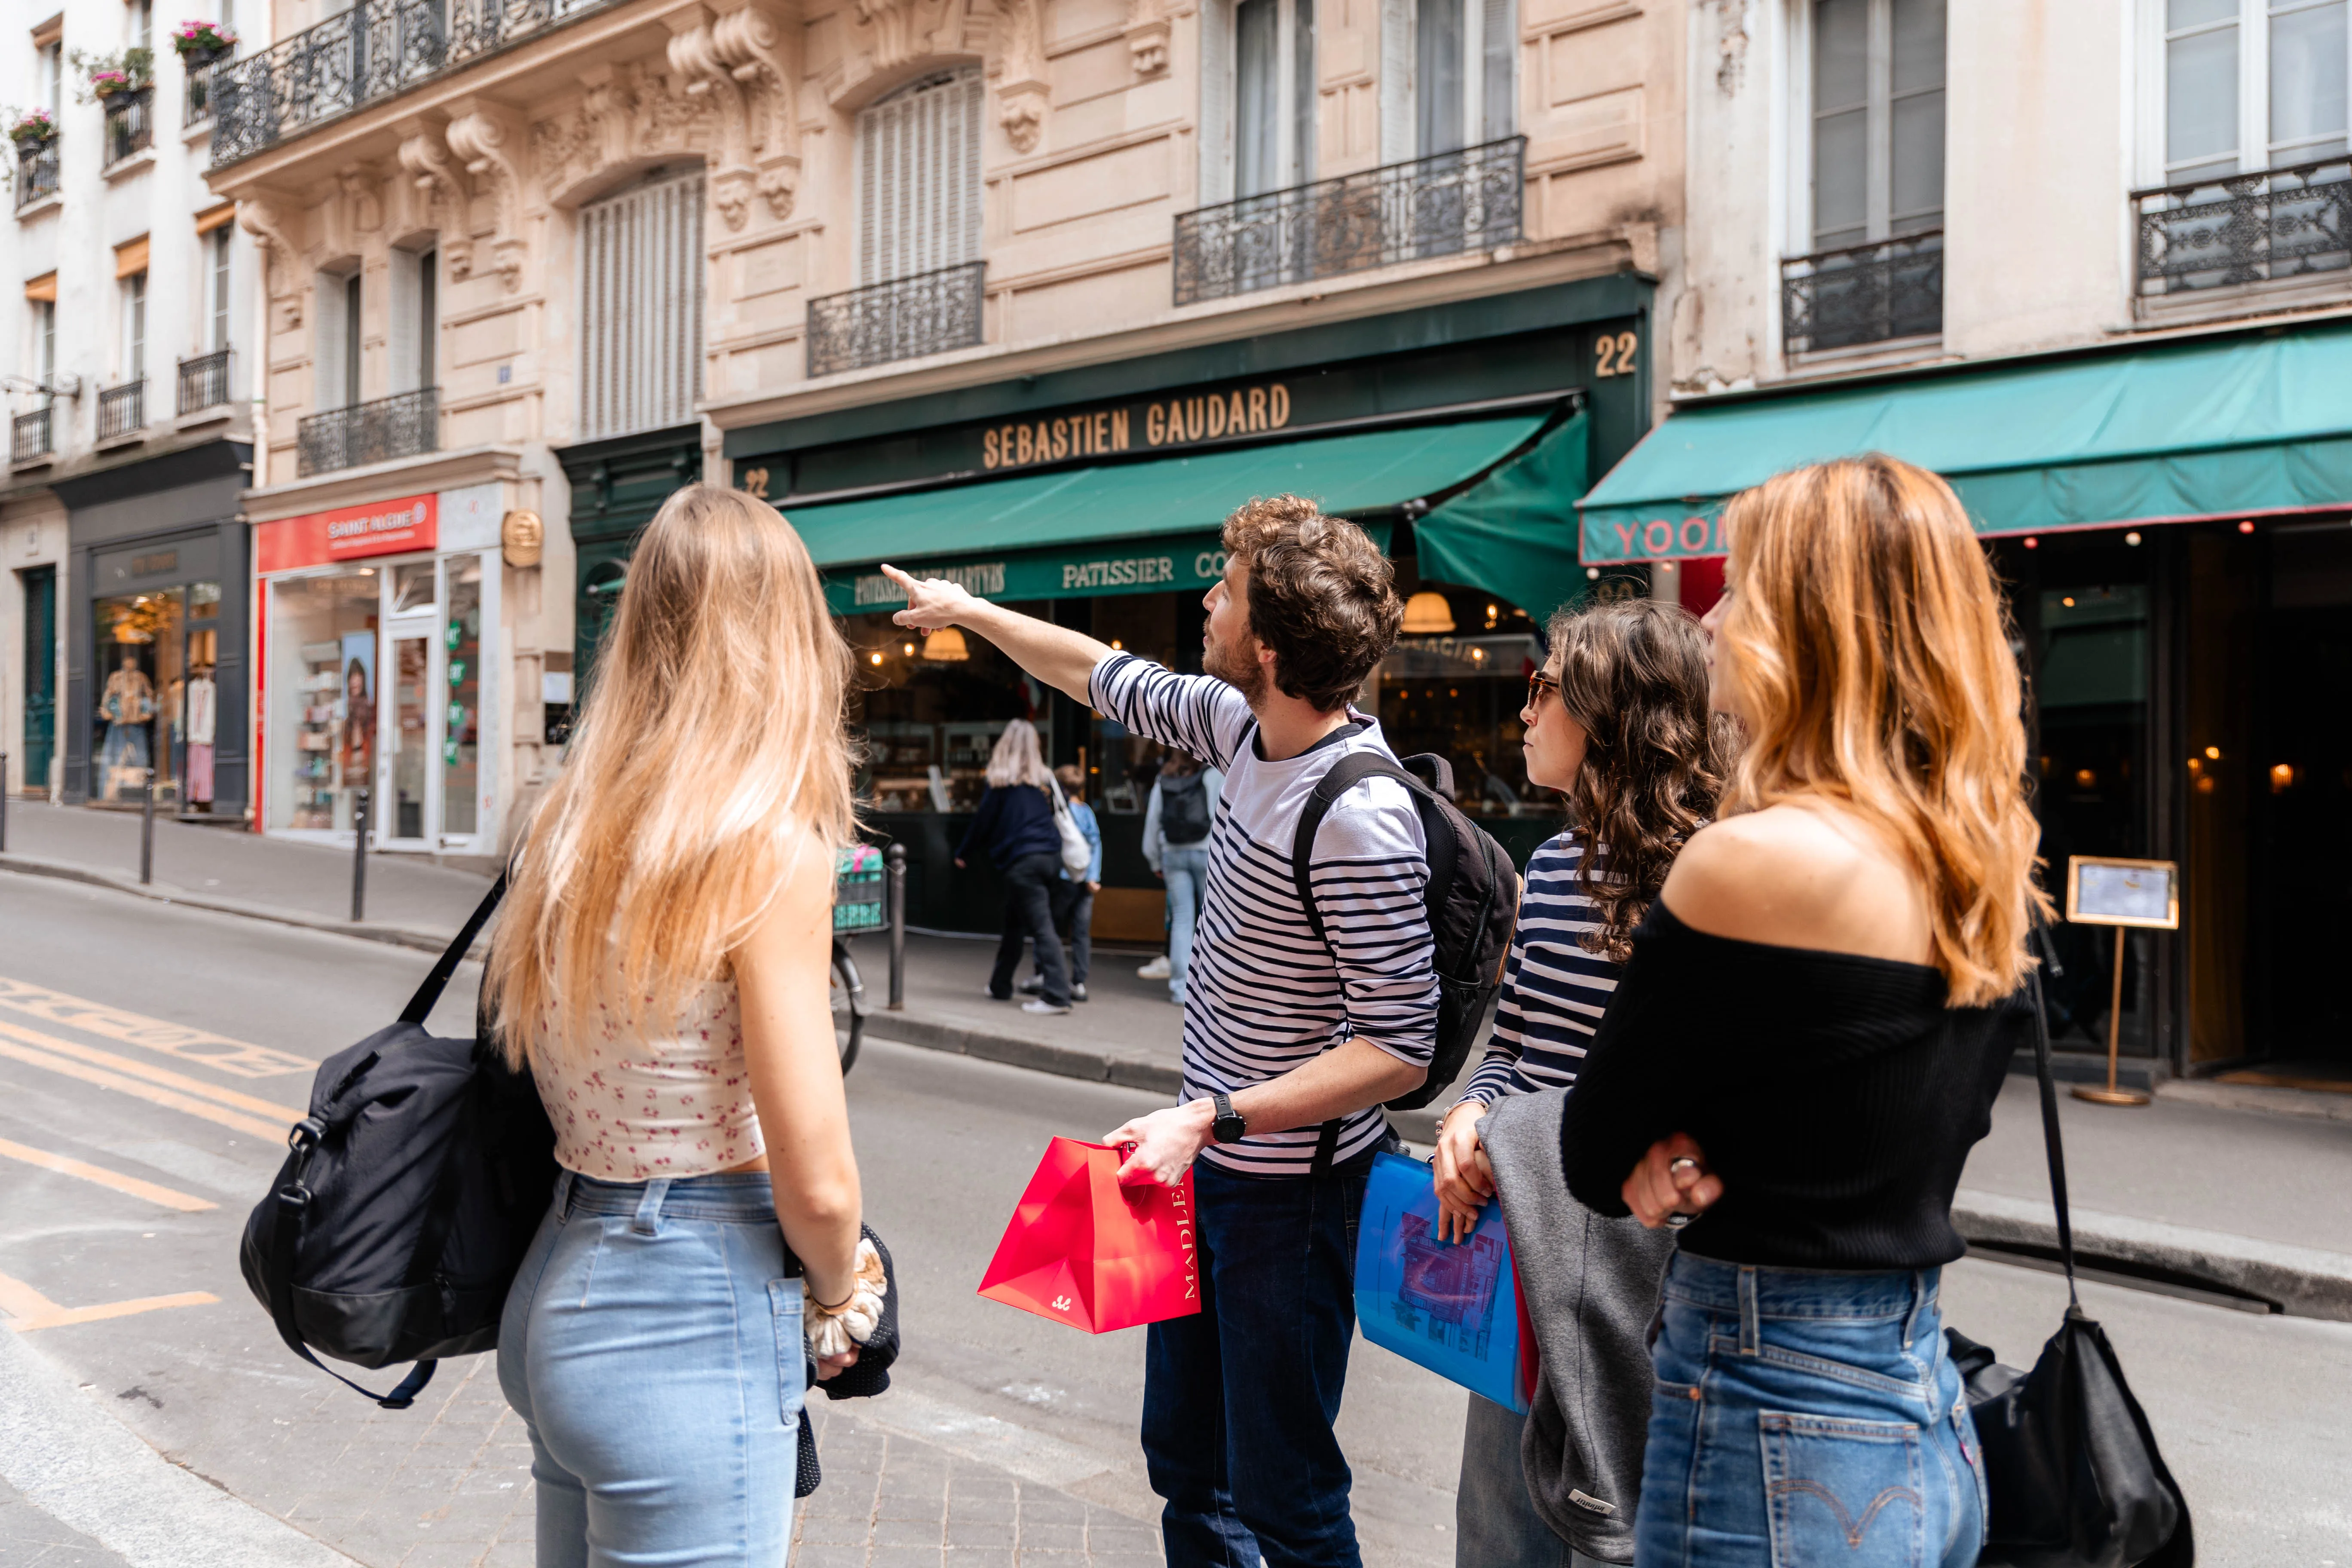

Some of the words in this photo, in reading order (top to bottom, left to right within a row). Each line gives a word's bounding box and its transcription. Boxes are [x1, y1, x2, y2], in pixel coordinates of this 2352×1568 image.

[1595, 331, 1637, 378] 22
[983, 409, 1130, 469] SEBASTIEN
[1146, 383, 1290, 446] GAUDARD
[329, 518, 369, 538] SAINT
[1063, 557, 1173, 589] PATISSIER
[1171, 1182, 1194, 1300] MADLE
